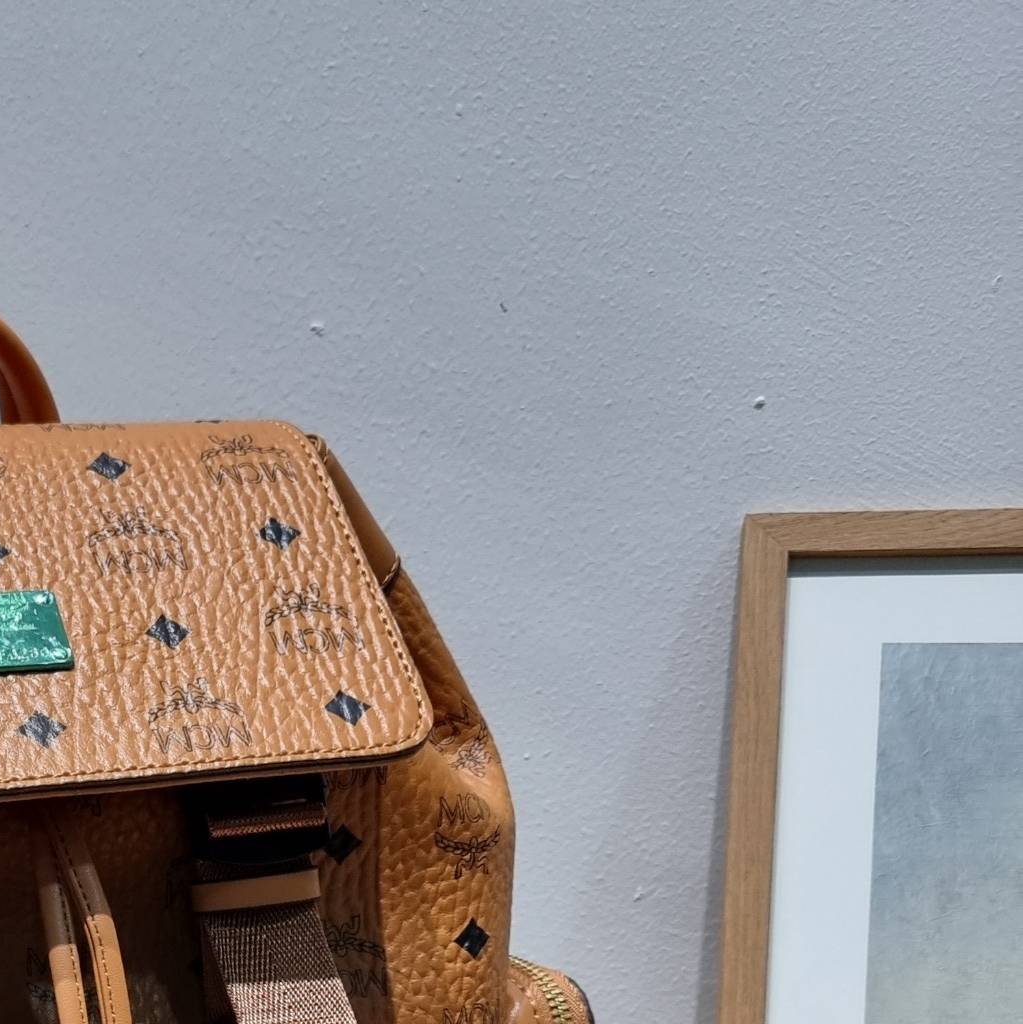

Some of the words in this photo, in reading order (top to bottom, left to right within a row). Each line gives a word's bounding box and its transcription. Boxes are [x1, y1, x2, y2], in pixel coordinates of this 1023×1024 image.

[204, 460, 296, 487] MCM
[92, 548, 190, 576] MCM
[267, 627, 365, 660] MCM
[151, 724, 253, 755] MCM
